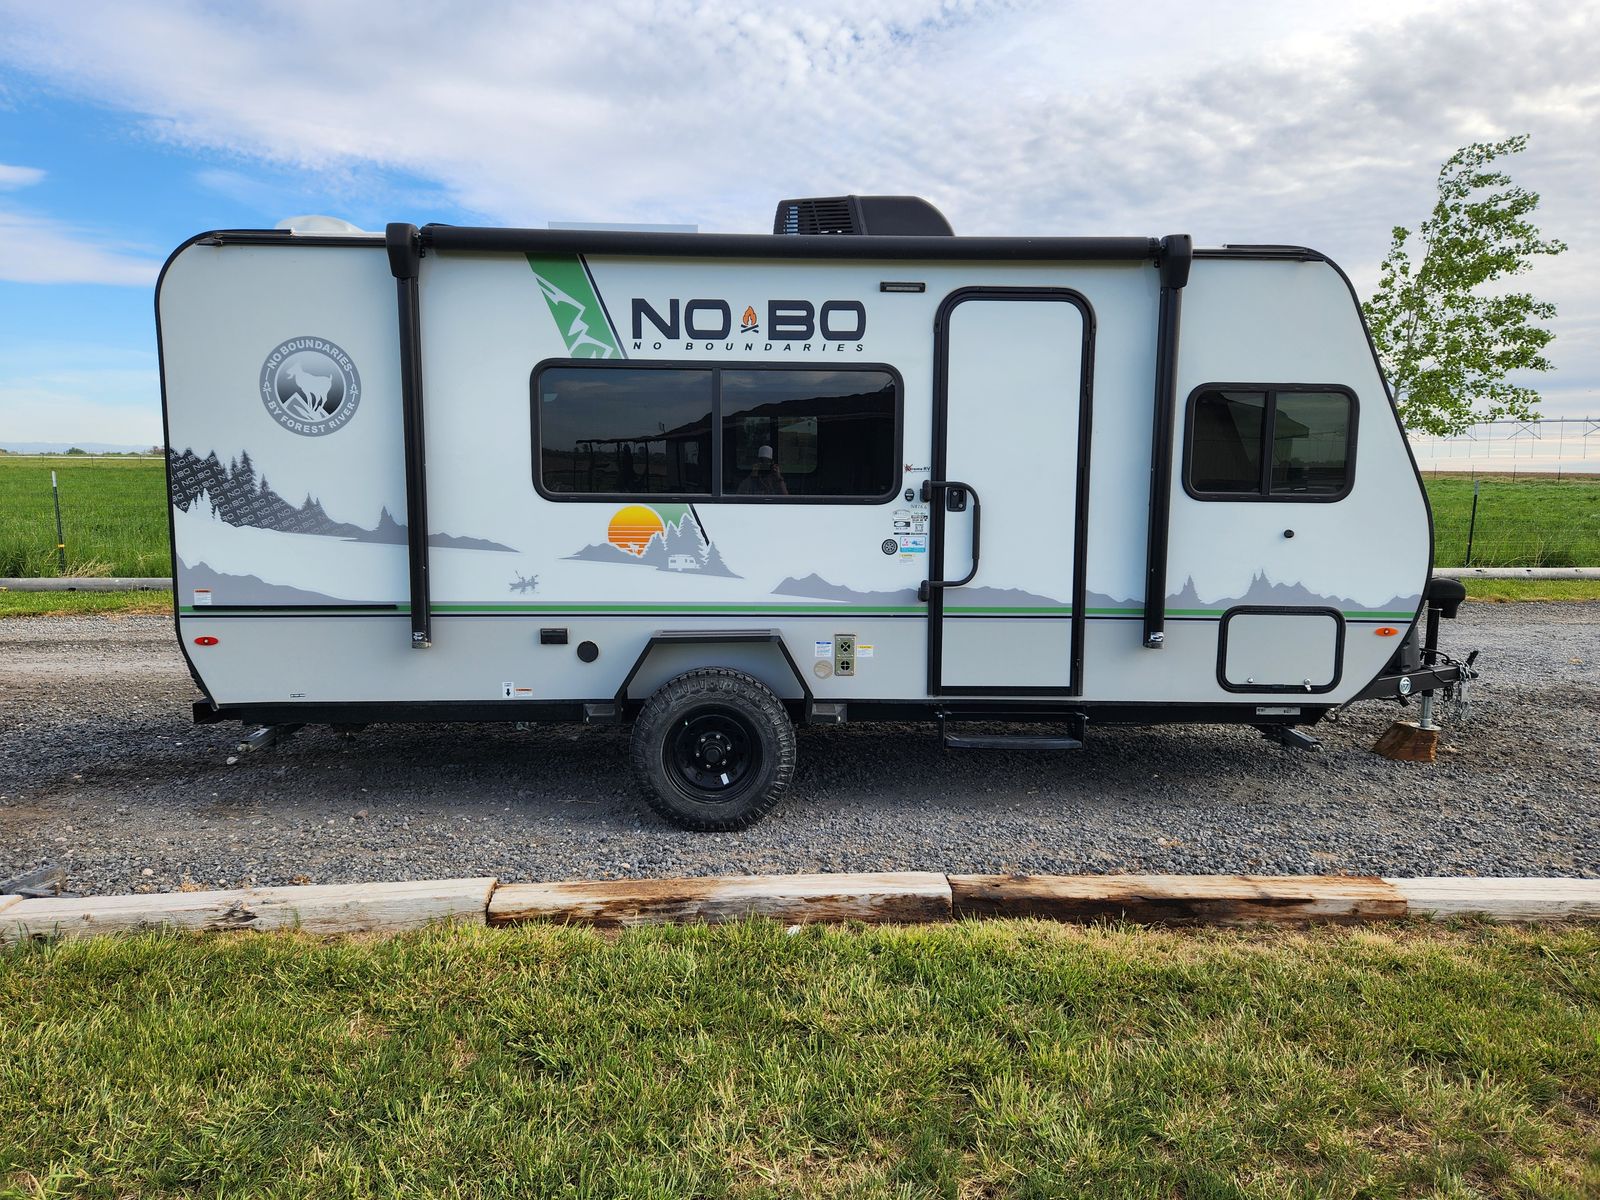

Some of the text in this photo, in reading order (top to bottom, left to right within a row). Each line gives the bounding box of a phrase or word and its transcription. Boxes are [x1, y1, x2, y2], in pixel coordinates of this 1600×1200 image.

[631, 298, 866, 341] NO BO
[267, 339, 352, 372] NO BOUNDARIES
[633, 341, 864, 352] NO BOUNDARIES
[268, 400, 355, 433] BY FOREST RIVER
